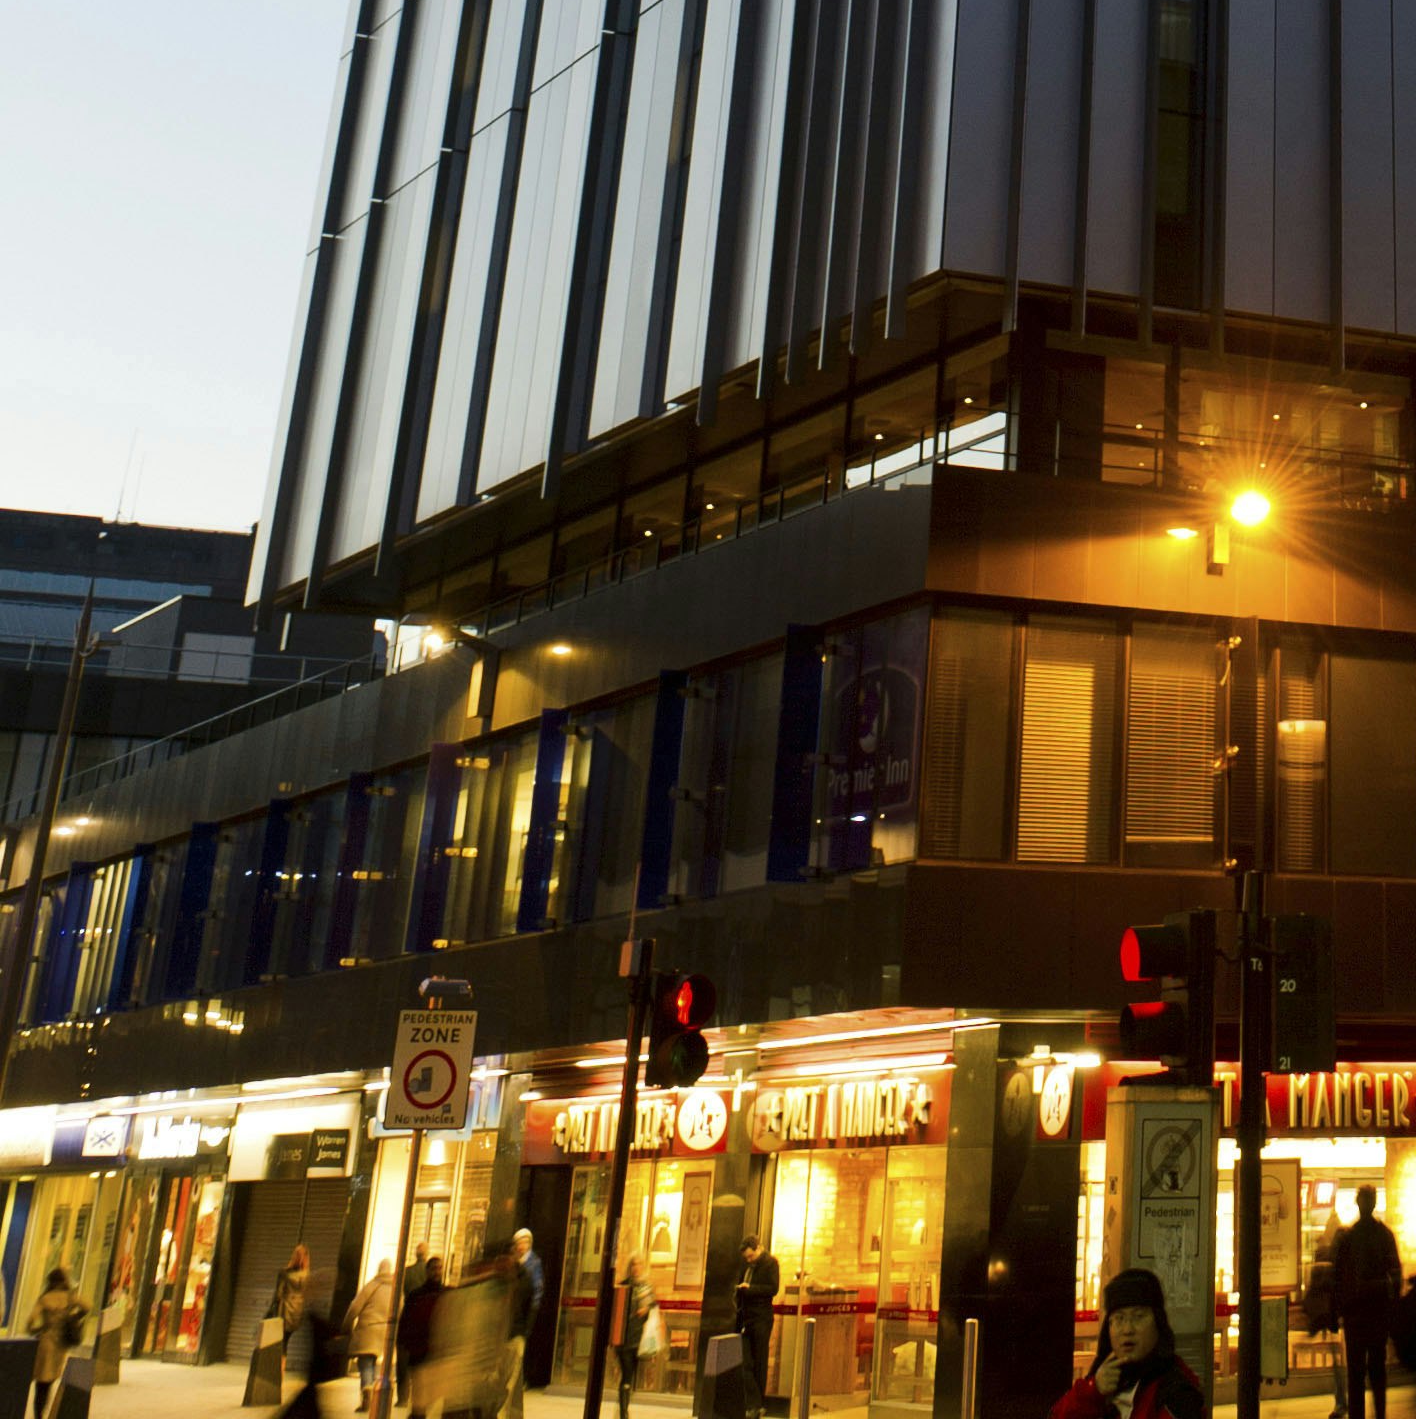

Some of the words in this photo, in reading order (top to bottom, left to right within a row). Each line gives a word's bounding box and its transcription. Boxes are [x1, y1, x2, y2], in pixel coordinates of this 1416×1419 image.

[886, 753, 909, 785] Inn
[1280, 979, 1297, 992] 20
[403, 1013, 474, 1024] PEDESTRIAN
[410, 1028, 462, 1043] ZONE
[1289, 1072, 1411, 1128] MANGER
[394, 1114, 410, 1124] No
[413, 1114, 455, 1124] vehicles
[1145, 1206, 1195, 1218] Pedestrian
